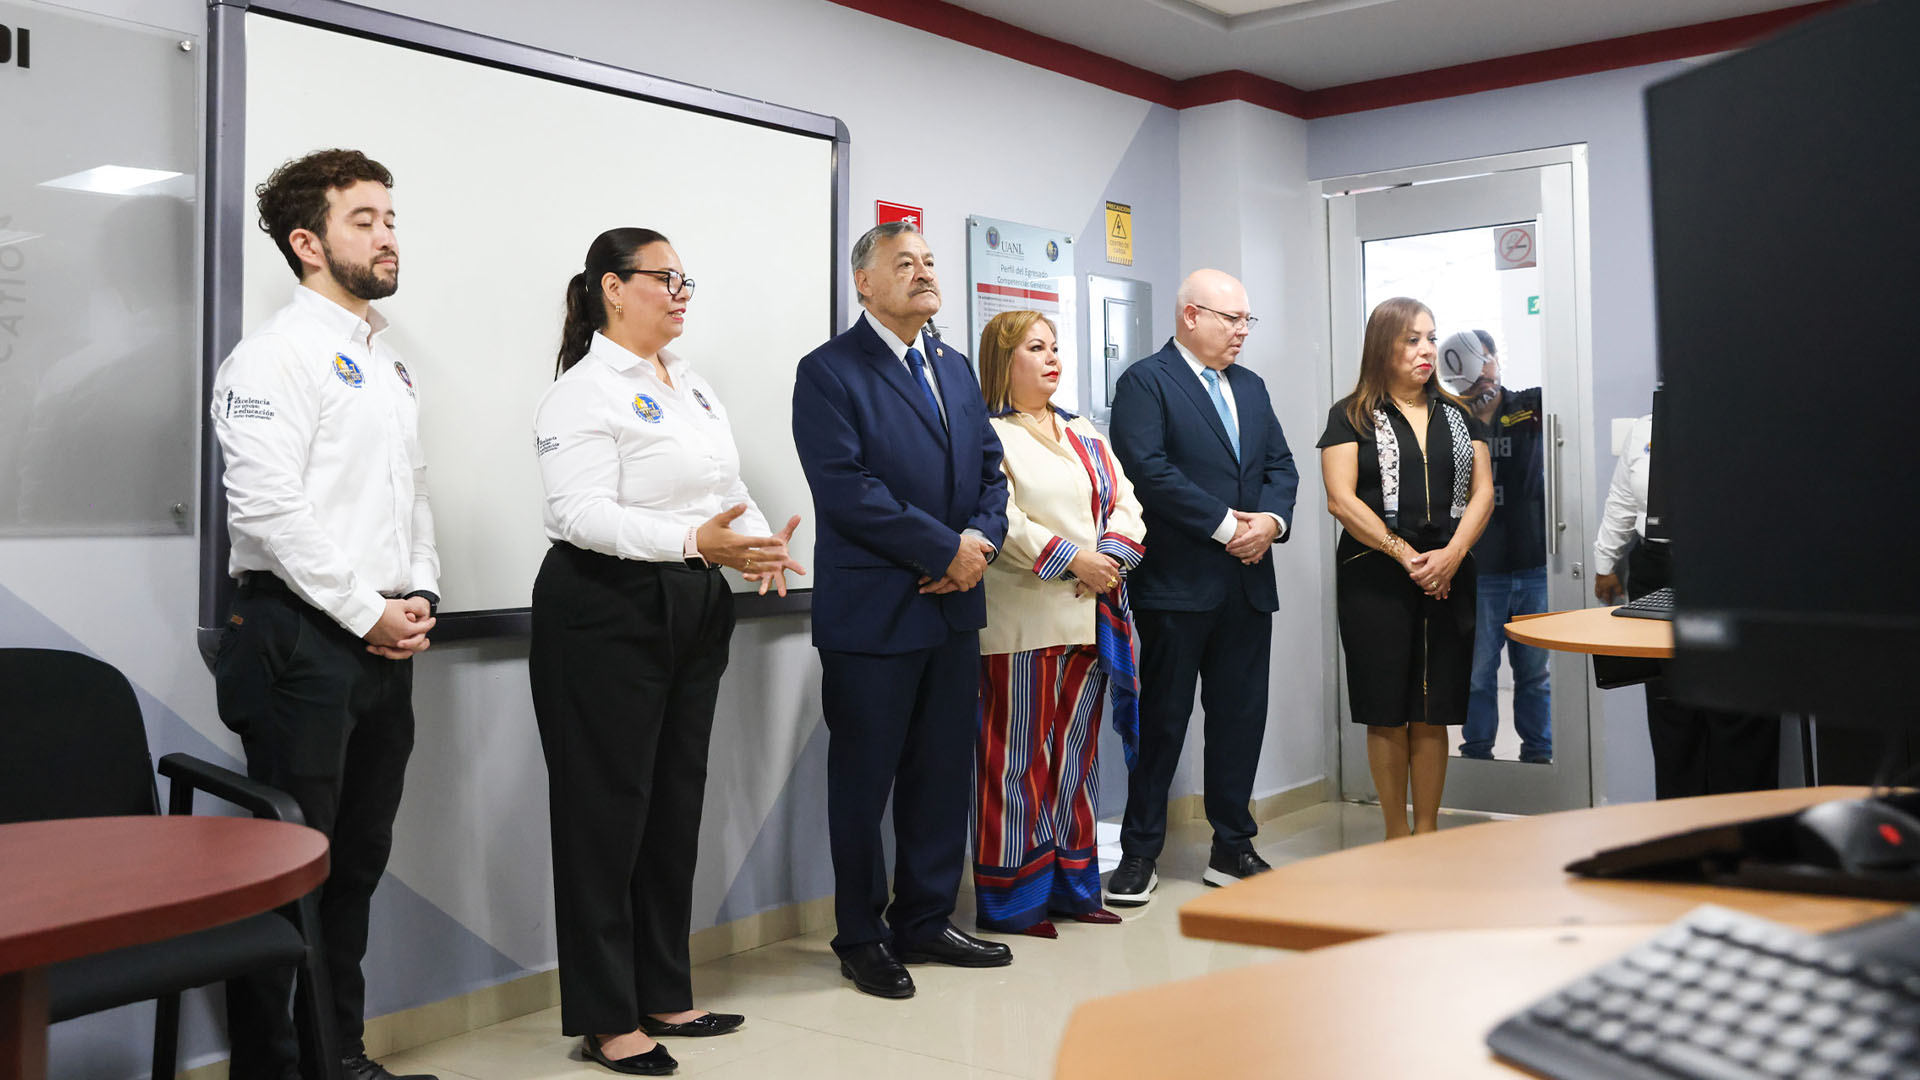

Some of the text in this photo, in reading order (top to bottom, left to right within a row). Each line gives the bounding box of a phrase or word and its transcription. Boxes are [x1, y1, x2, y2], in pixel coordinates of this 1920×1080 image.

[1001, 241, 1024, 255] UANL
[1000, 264, 1014, 274] Perfil
[1016, 266, 1024, 275] del
